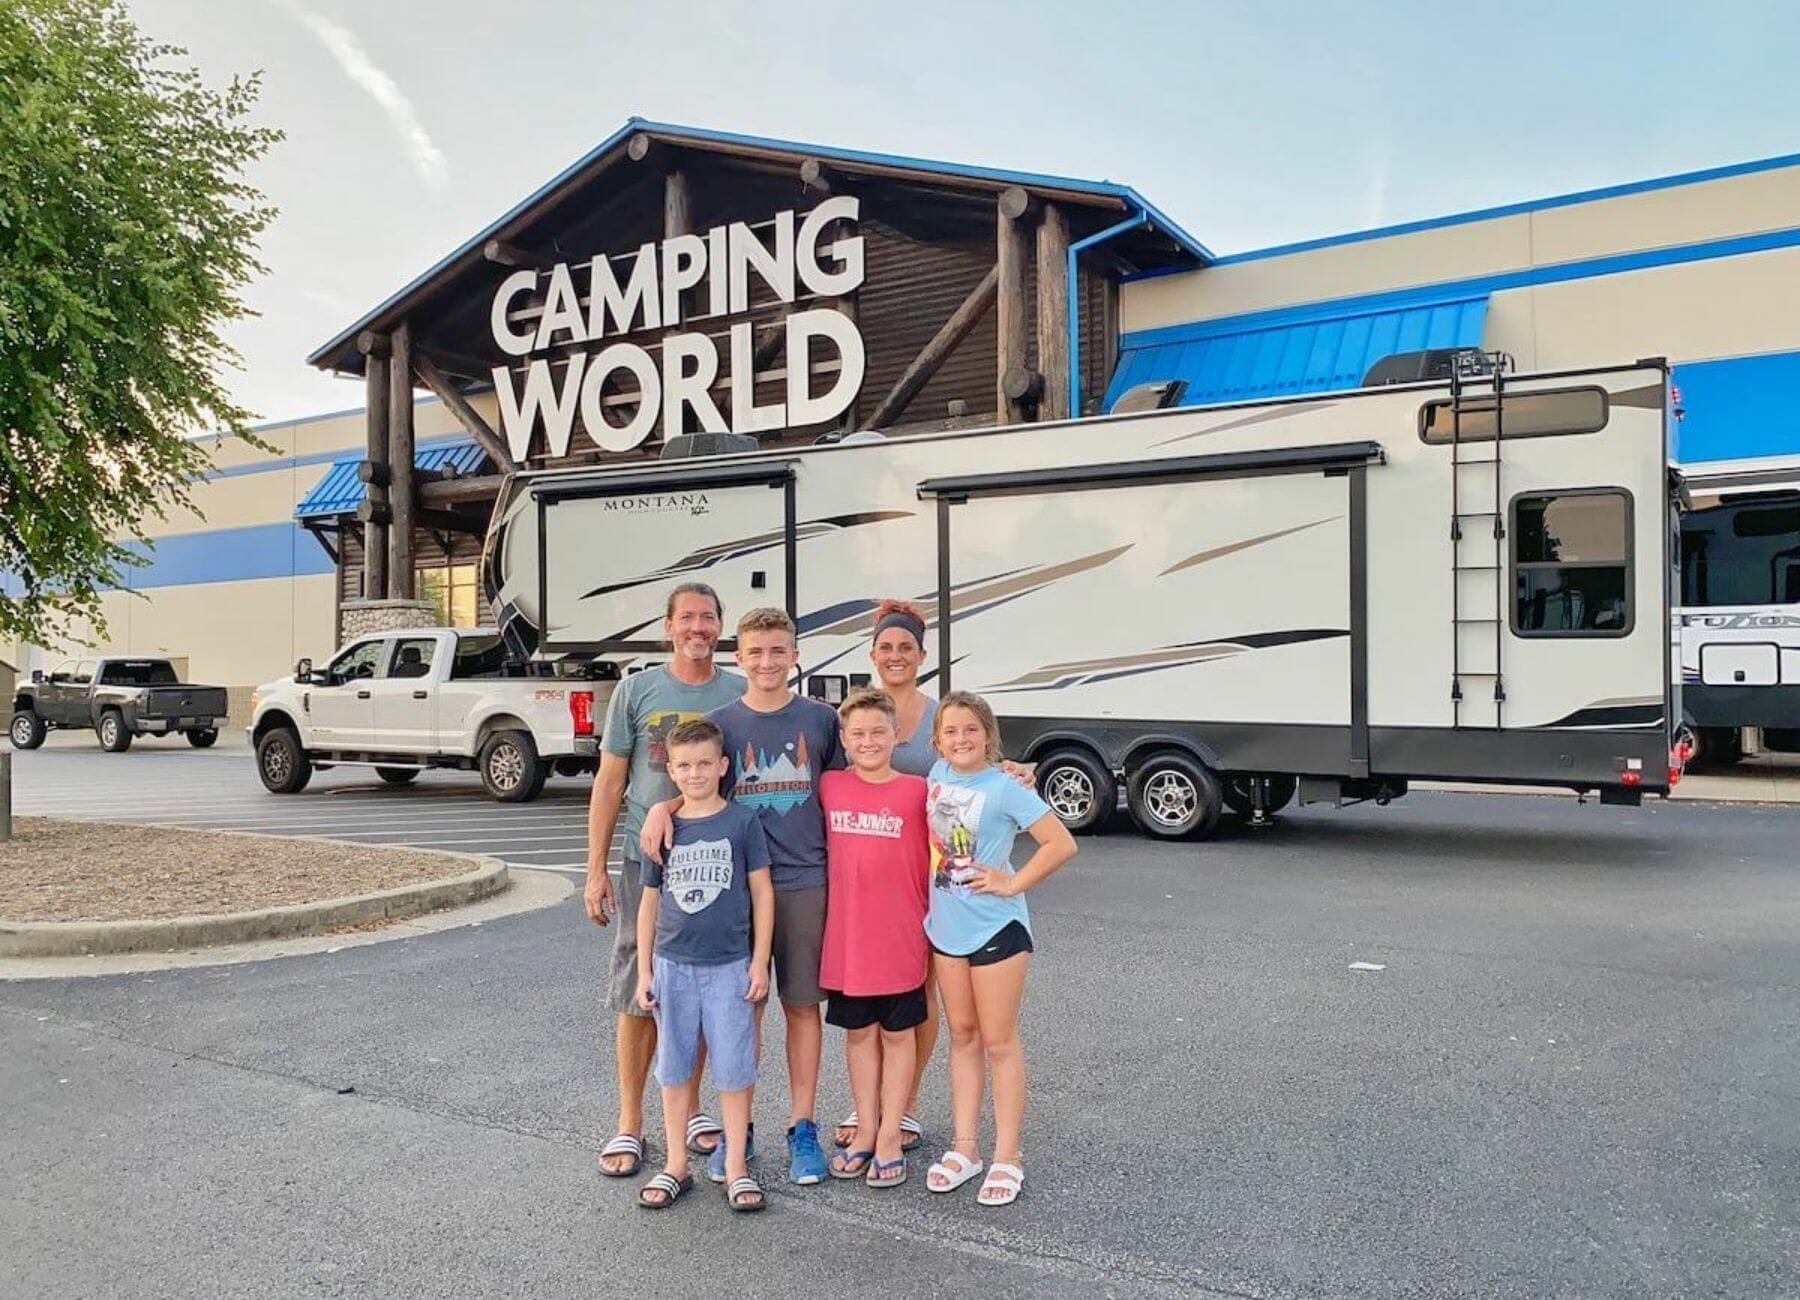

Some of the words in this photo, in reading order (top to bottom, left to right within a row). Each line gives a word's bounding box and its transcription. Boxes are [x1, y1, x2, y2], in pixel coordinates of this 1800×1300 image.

[491, 195, 865, 356] CAMPING
[491, 308, 866, 464] WORLD
[604, 494, 708, 511] MONTANA
[671, 848, 728, 867] FULLTIME
[670, 866, 730, 885] FAMILIES
